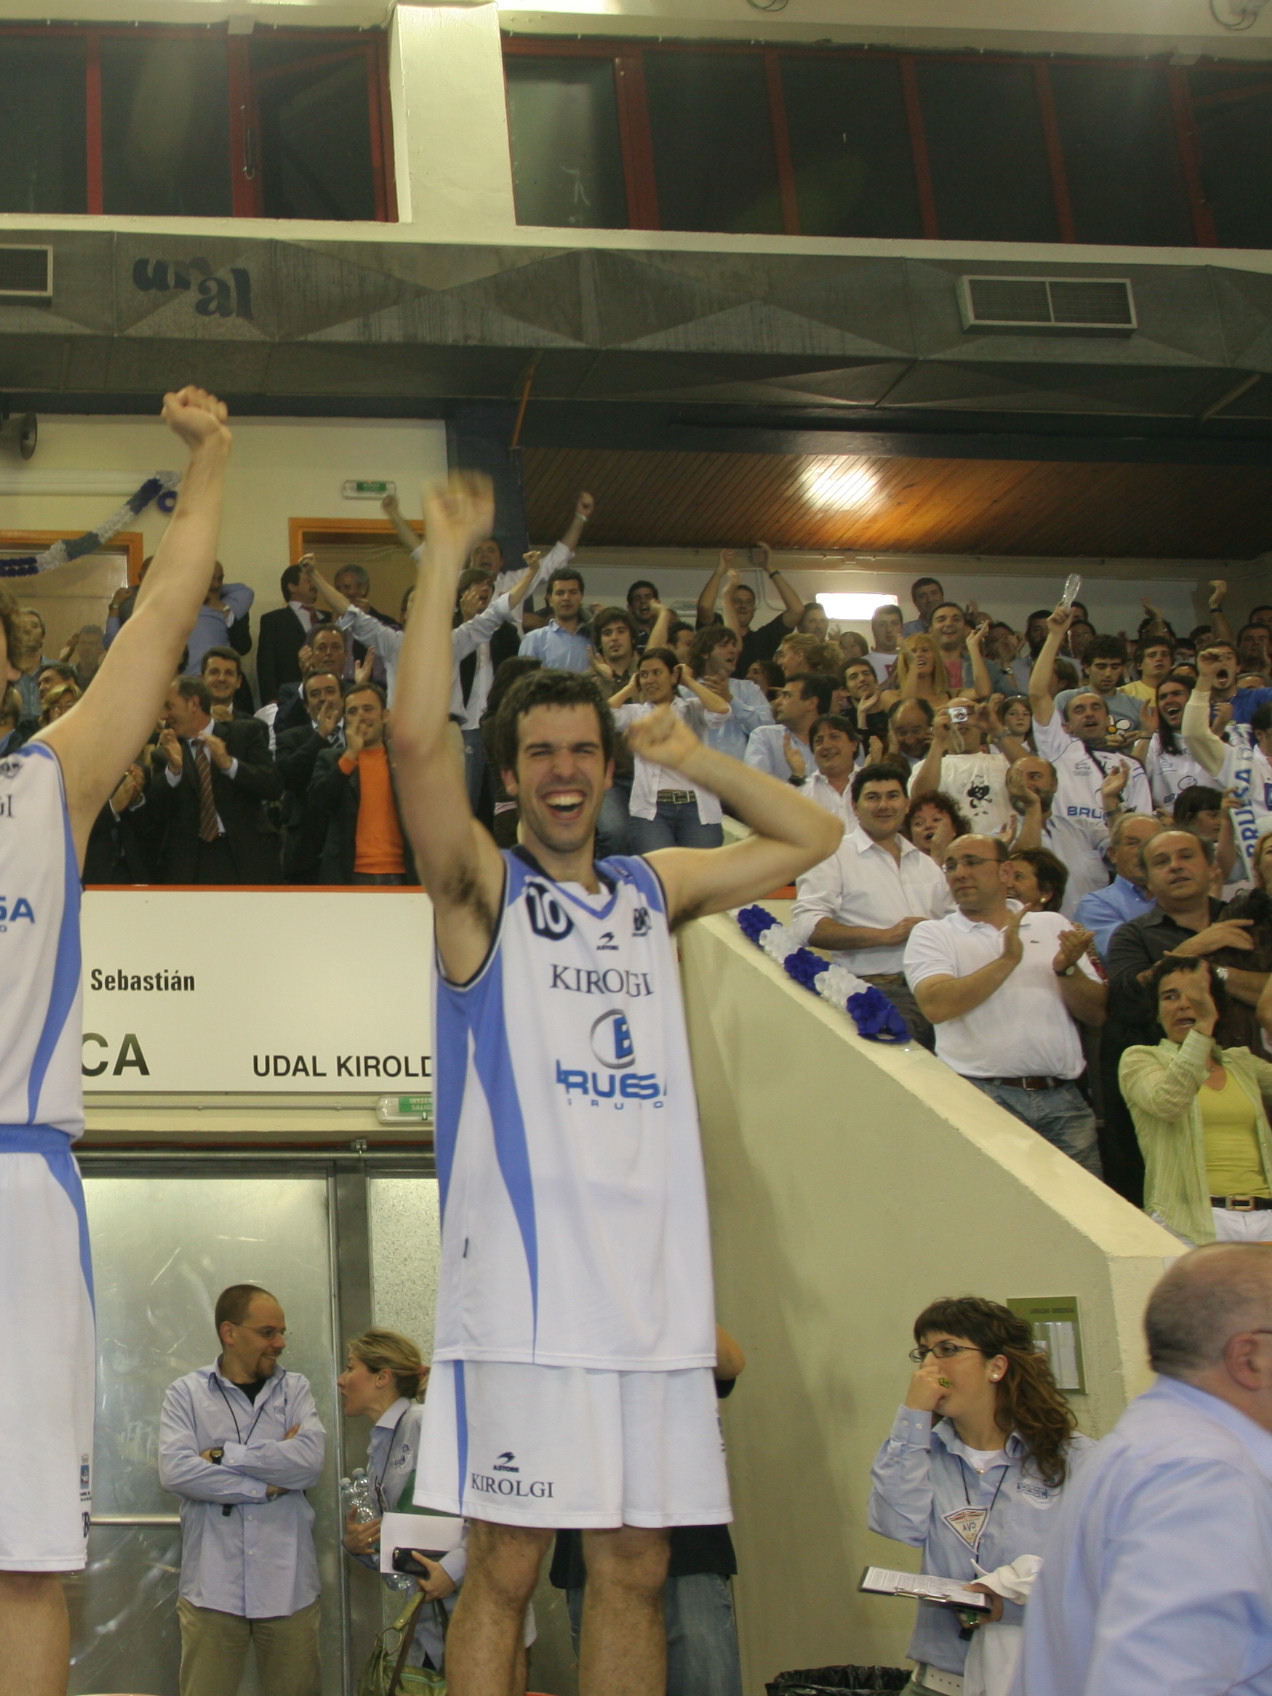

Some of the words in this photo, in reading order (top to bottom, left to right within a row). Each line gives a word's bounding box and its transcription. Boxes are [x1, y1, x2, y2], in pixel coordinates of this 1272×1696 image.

[528, 887, 569, 933] 10
[90, 968, 195, 991] Sebastián
[82, 1032, 151, 1077] CA
[253, 1055, 327, 1077] UDAL
[471, 1473, 554, 1498] KIROLGI
